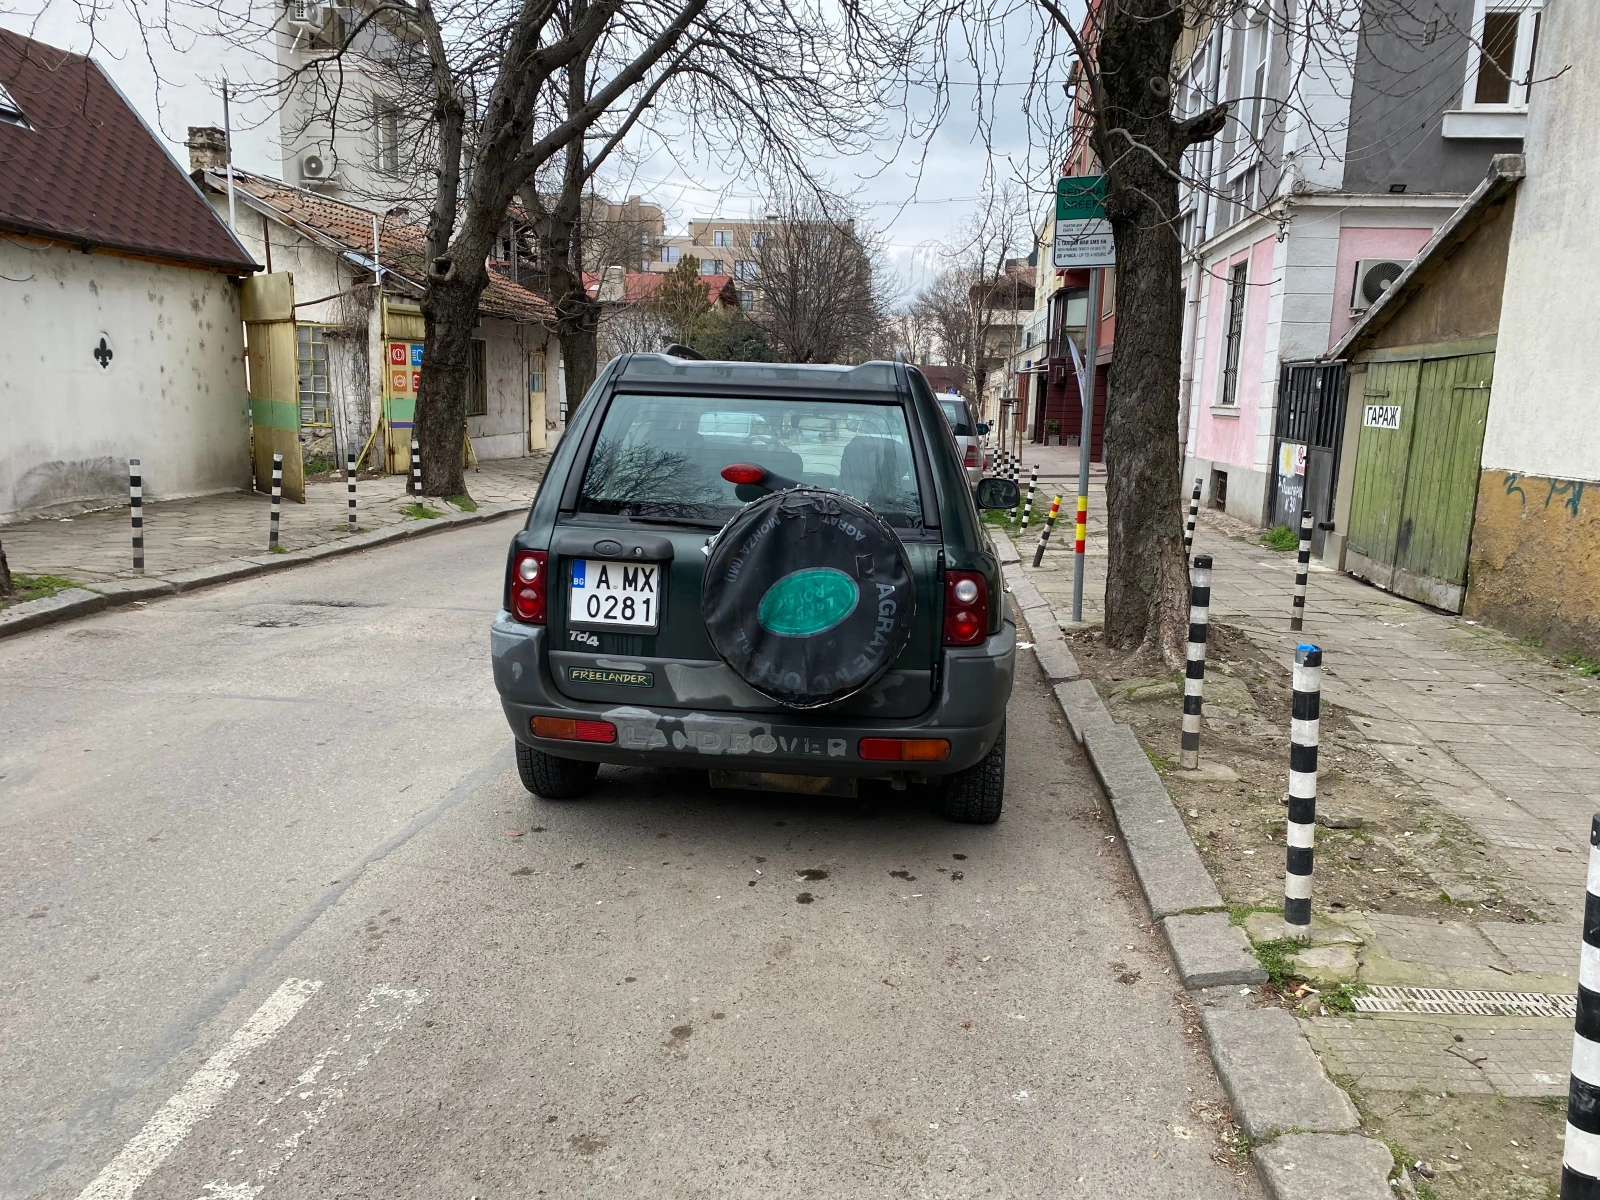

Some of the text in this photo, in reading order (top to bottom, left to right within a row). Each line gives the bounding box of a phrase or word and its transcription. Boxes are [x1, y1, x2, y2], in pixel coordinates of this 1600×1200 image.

[1366, 406, 1399, 427] ГАРАЖ
[724, 514, 782, 583] MONZA (MI)
[573, 577, 584, 586] BG
[595, 564, 655, 593] A MX
[586, 593, 652, 622] 0281
[569, 630, 599, 647] Td4
[853, 583, 898, 672] AGRATE
[572, 670, 649, 685] FREELANDER
[625, 726, 848, 757] LAND ROVER
